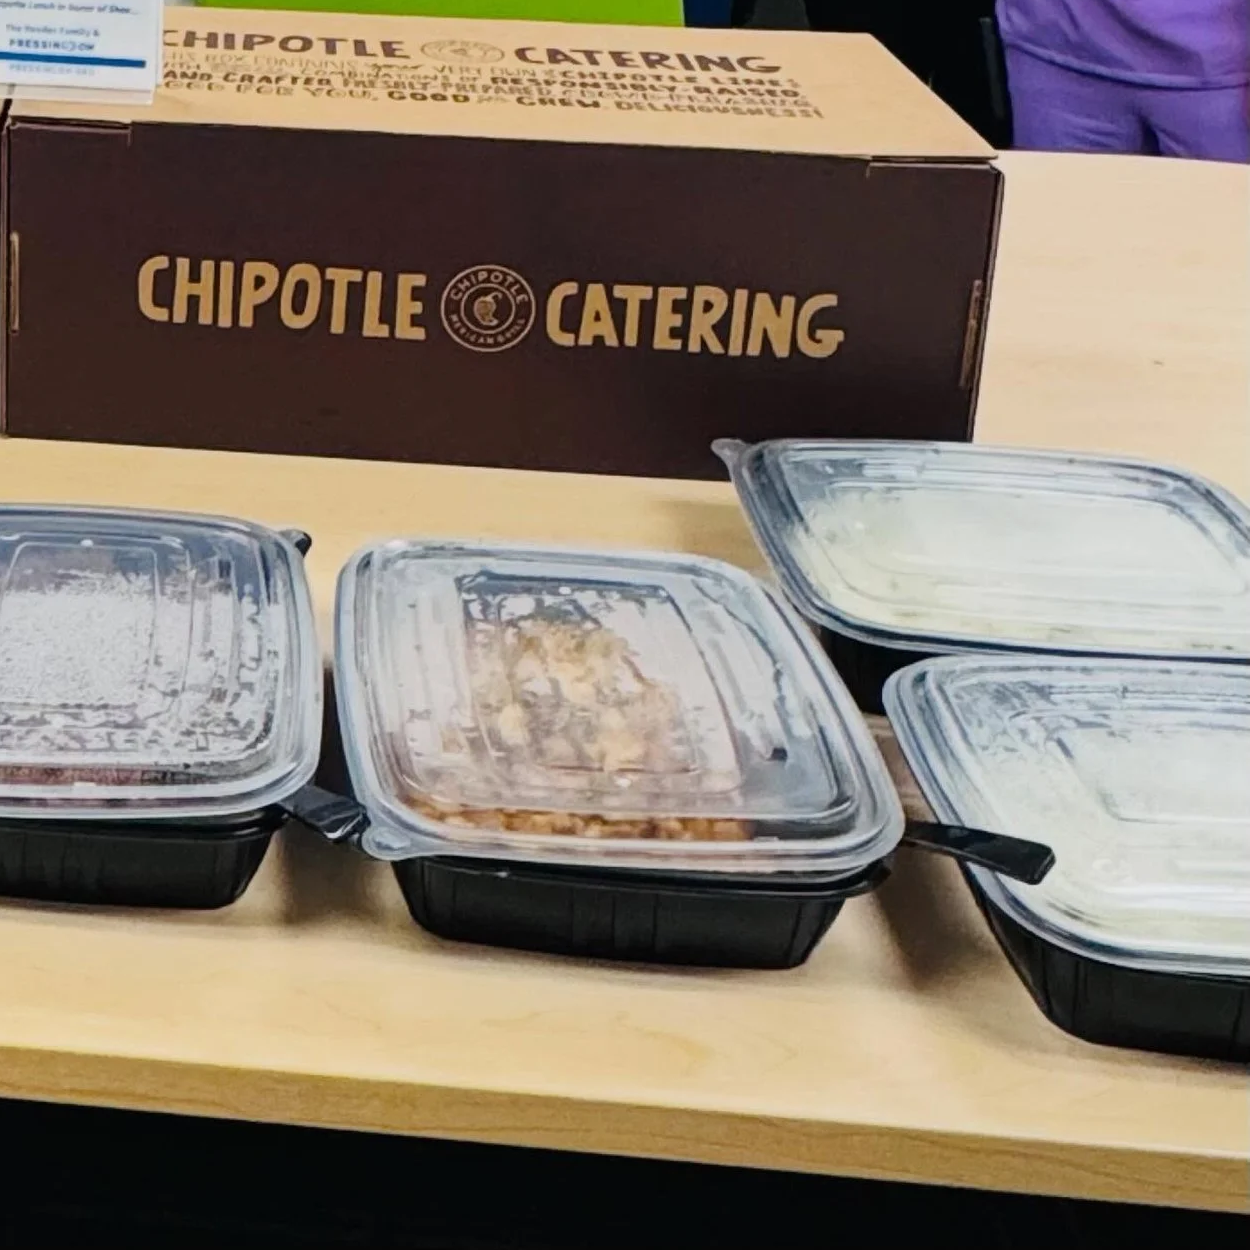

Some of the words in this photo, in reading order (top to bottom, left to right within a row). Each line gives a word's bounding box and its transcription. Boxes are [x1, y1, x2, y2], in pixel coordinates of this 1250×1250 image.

[163, 29, 411, 60] CHIPOTLE
[514, 46, 782, 74] CATERING
[387, 90, 471, 103] GOOD
[138, 255, 427, 342] CHIPOTLE
[450, 270, 529, 305] CHIPOTLE
[546, 280, 845, 359] CATERING
